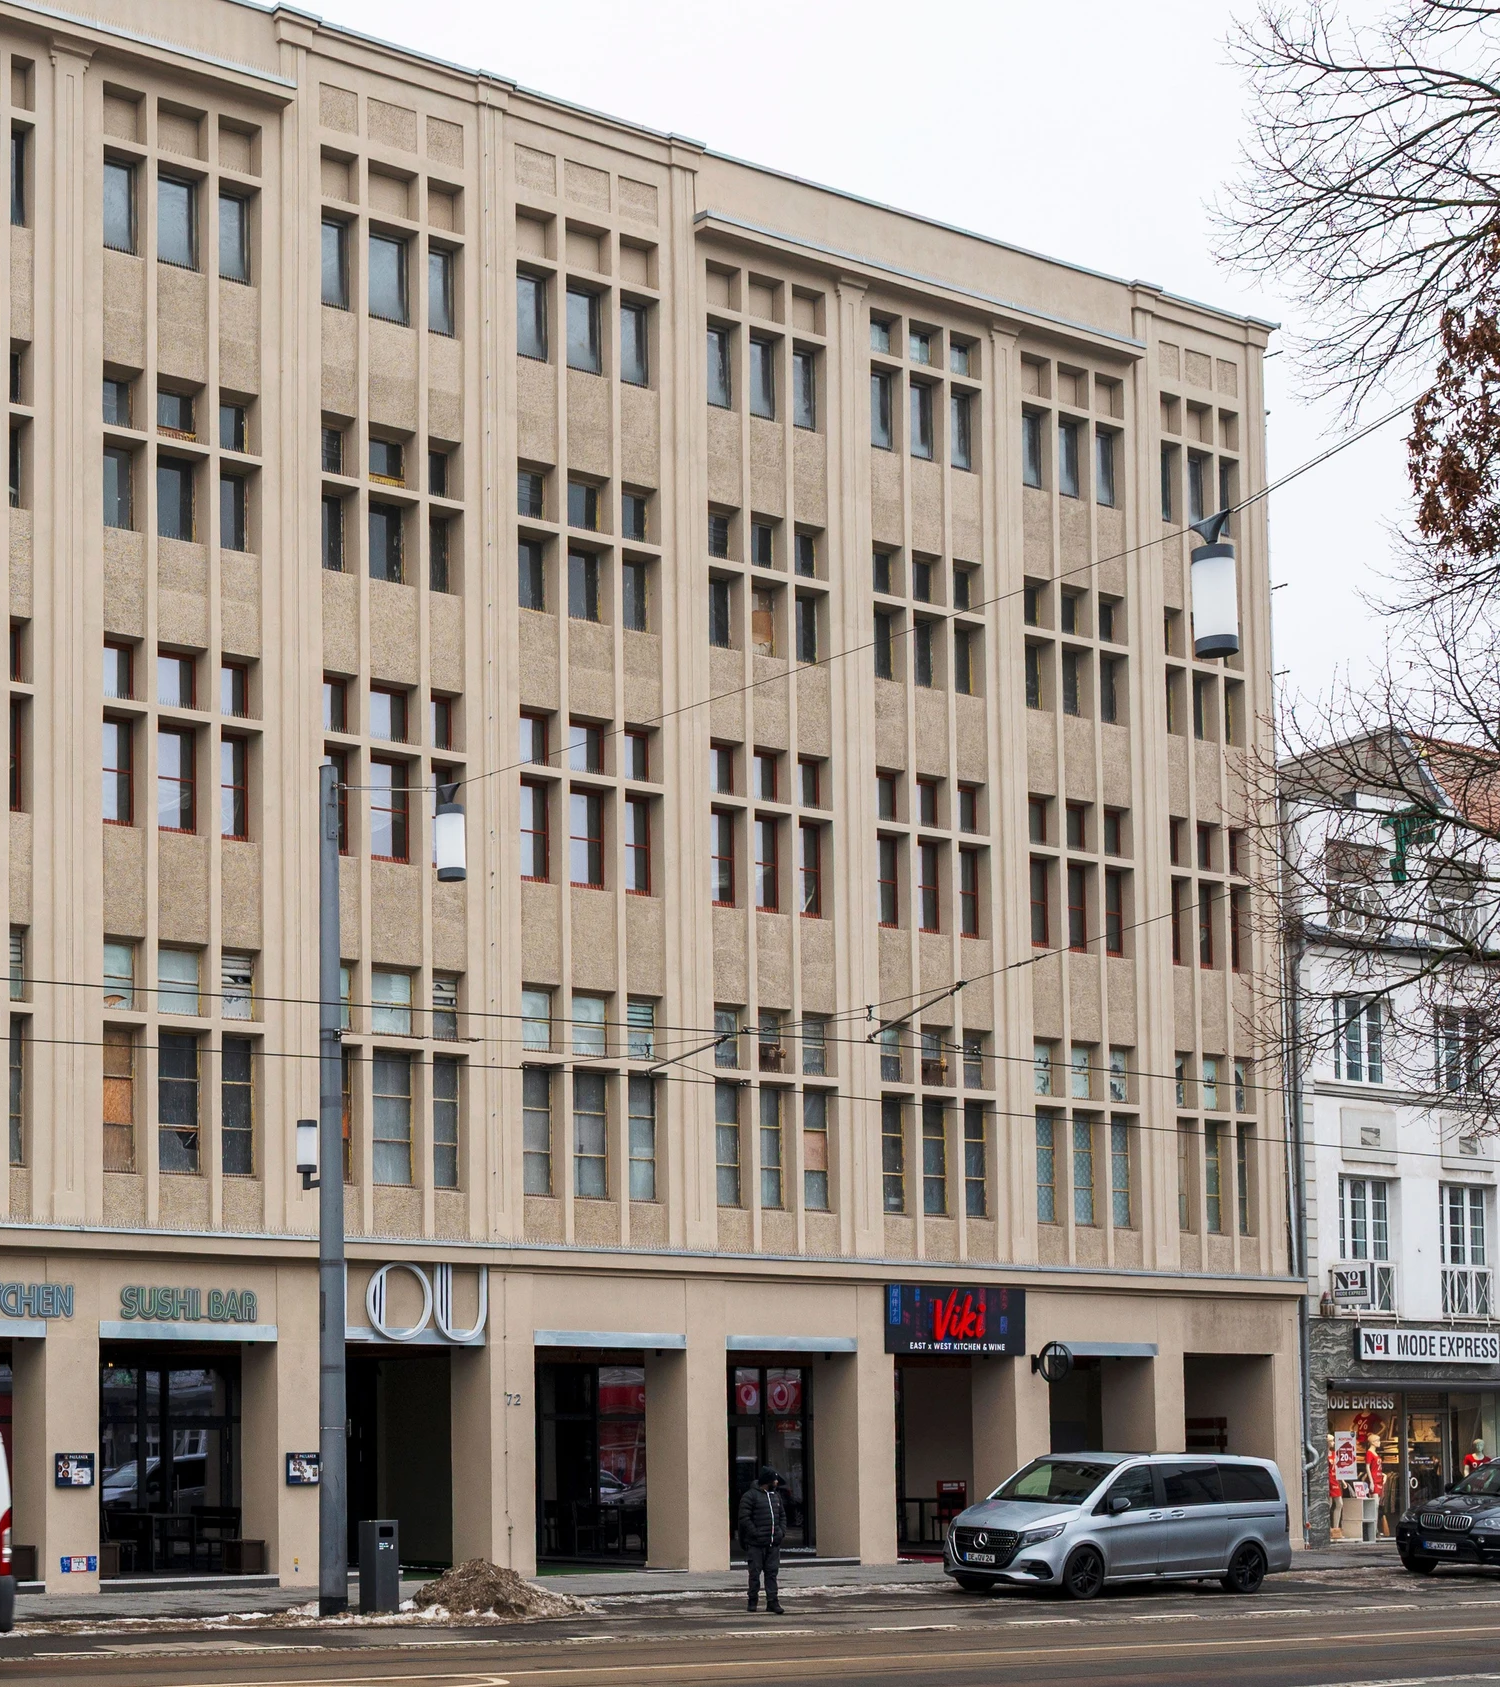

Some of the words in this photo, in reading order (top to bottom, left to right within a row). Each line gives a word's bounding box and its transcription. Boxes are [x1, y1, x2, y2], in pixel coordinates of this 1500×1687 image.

[121, 1286, 201, 1320] SUSHI
[208, 1289, 257, 1322] BAR
[932, 1288, 987, 1341] Viki
[910, 1342, 926, 1350] EAST
[953, 1343, 981, 1351] KITCHEN
[982, 1343, 988, 1351] &
[988, 1343, 1006, 1351] WINE
[1397, 1334, 1436, 1356] MODE
[1440, 1336, 1498, 1359] EXPRESS
[506, 1394, 521, 1406] 72
[1352, 1396, 1394, 1409] EXPRESS
